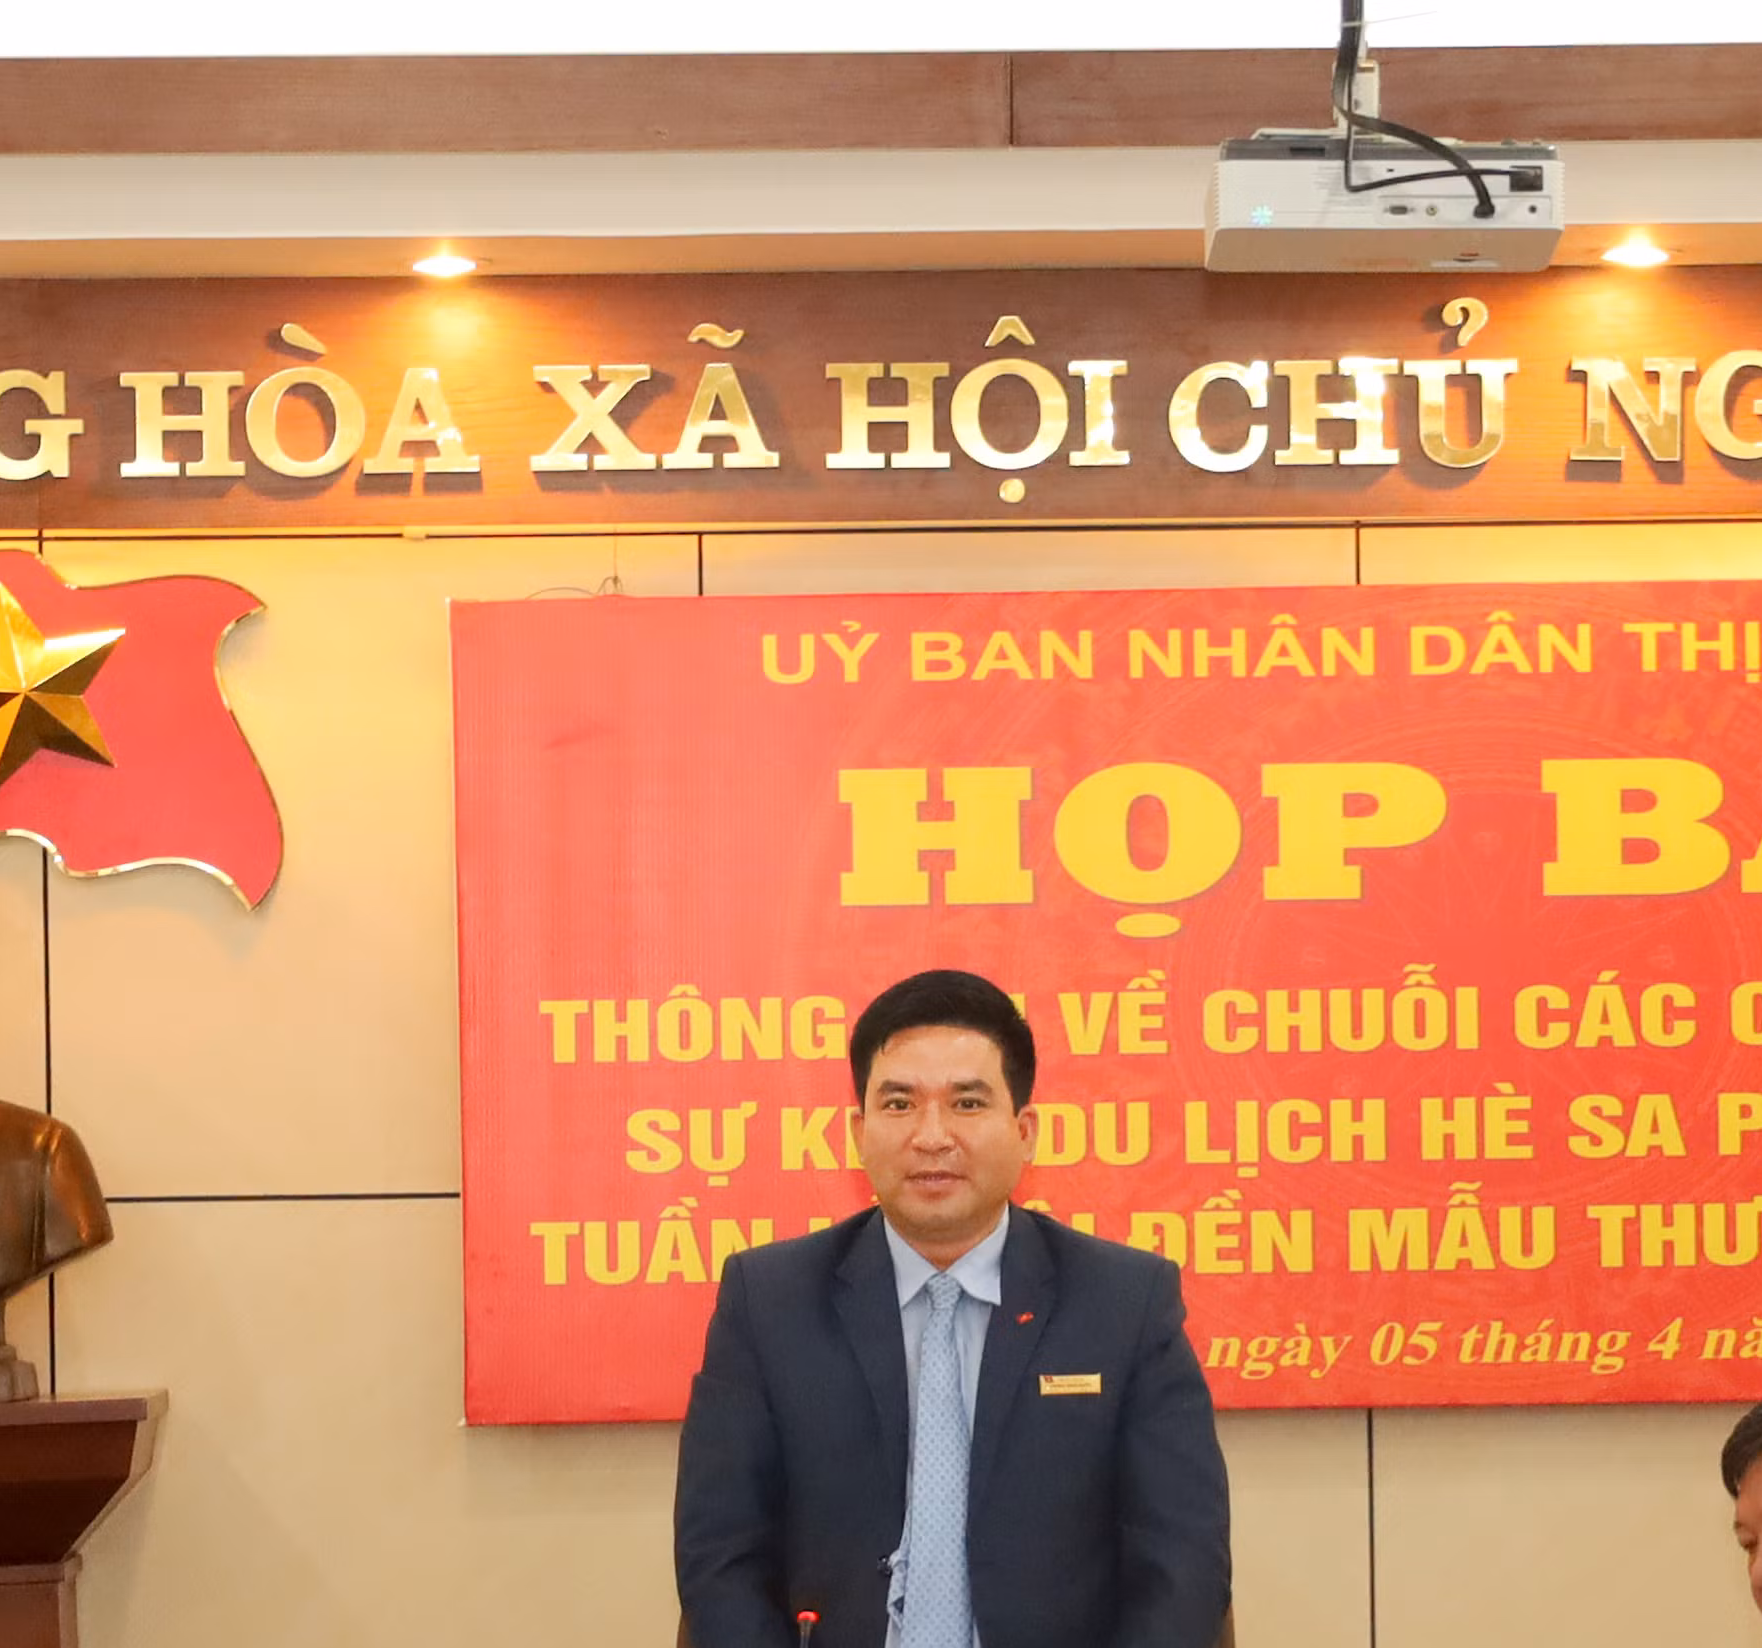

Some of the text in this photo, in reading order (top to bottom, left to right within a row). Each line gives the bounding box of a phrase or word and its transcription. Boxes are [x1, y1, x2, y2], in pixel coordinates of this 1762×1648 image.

[119, 322, 481, 478] HÒA
[529, 322, 780, 471] XÃ
[825, 315, 1130, 504] HỘI
[1168, 296, 1518, 473] CHỦ
[761, 621, 880, 685] UỶ
[910, 628, 1094, 682] BAN
[1128, 613, 1376, 679] NHÂN
[1409, 608, 1593, 676] DÂN
[1621, 620, 1761, 684] THỊ
[837, 761, 1448, 938] HỌP
[540, 984, 848, 1064] THÔNG
[1057, 969, 1169, 1056] VỀ
[1202, 963, 1479, 1054] CHUỖI
[1514, 970, 1696, 1049] CÁC
[625, 1101, 758, 1187] SỰ
[1032, 1101, 1151, 1167] DU
[1184, 1098, 1386, 1178] LỊCH
[1420, 1082, 1534, 1161] HÈ
[1568, 1093, 1686, 1159] SA
[1126, 1188, 1314, 1274] ĐỀN
[1348, 1181, 1555, 1272] MẪU
[1205, 1323, 1353, 1379] ngày
[1369, 1321, 1444, 1366] 05
[1458, 1318, 1631, 1374] tháng
[1648, 1318, 1682, 1361] 4
